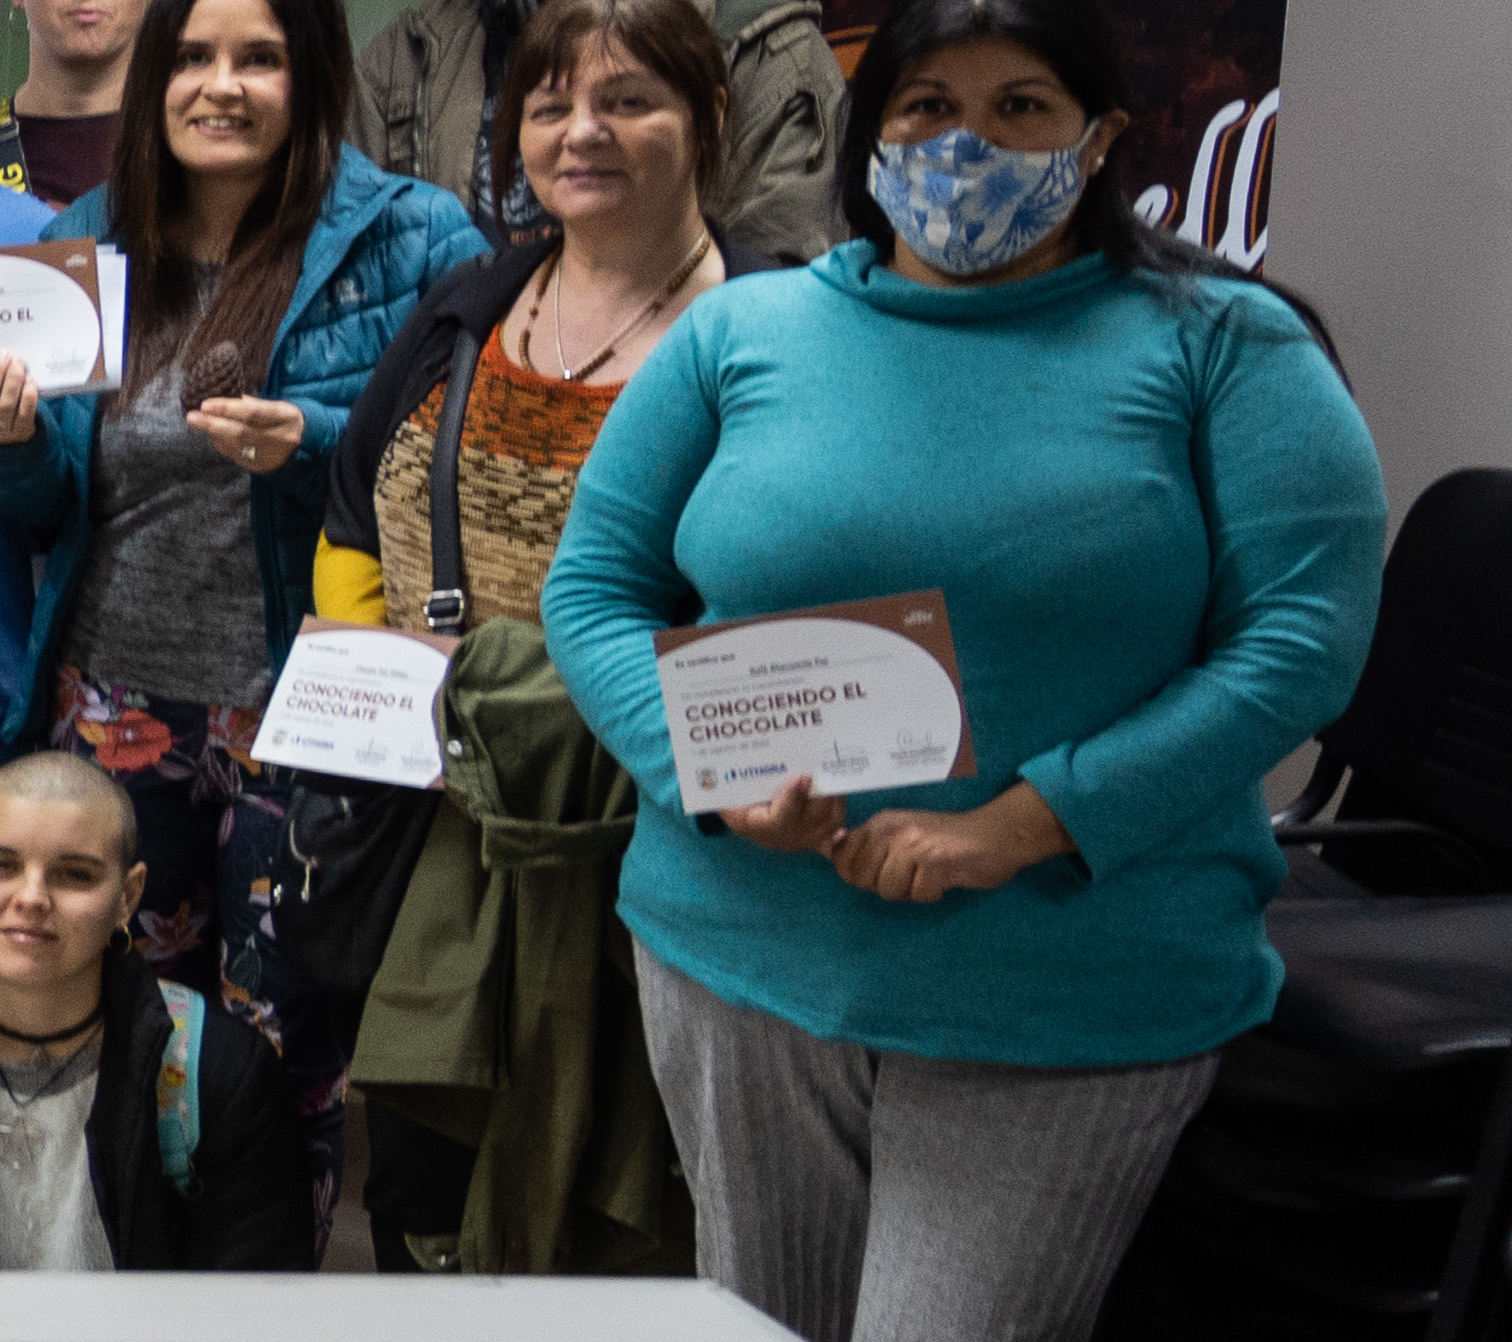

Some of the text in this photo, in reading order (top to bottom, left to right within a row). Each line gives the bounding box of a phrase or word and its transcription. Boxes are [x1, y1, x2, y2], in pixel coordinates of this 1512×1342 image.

[17, 308, 34, 321] EL
[286, 694, 379, 723] CHOCOLATE
[293, 678, 414, 709] CONOCIENDO EL
[686, 685, 837, 723] CONOCIENDO
[843, 682, 867, 700] EL
[689, 709, 823, 744] CHOCOLATE
